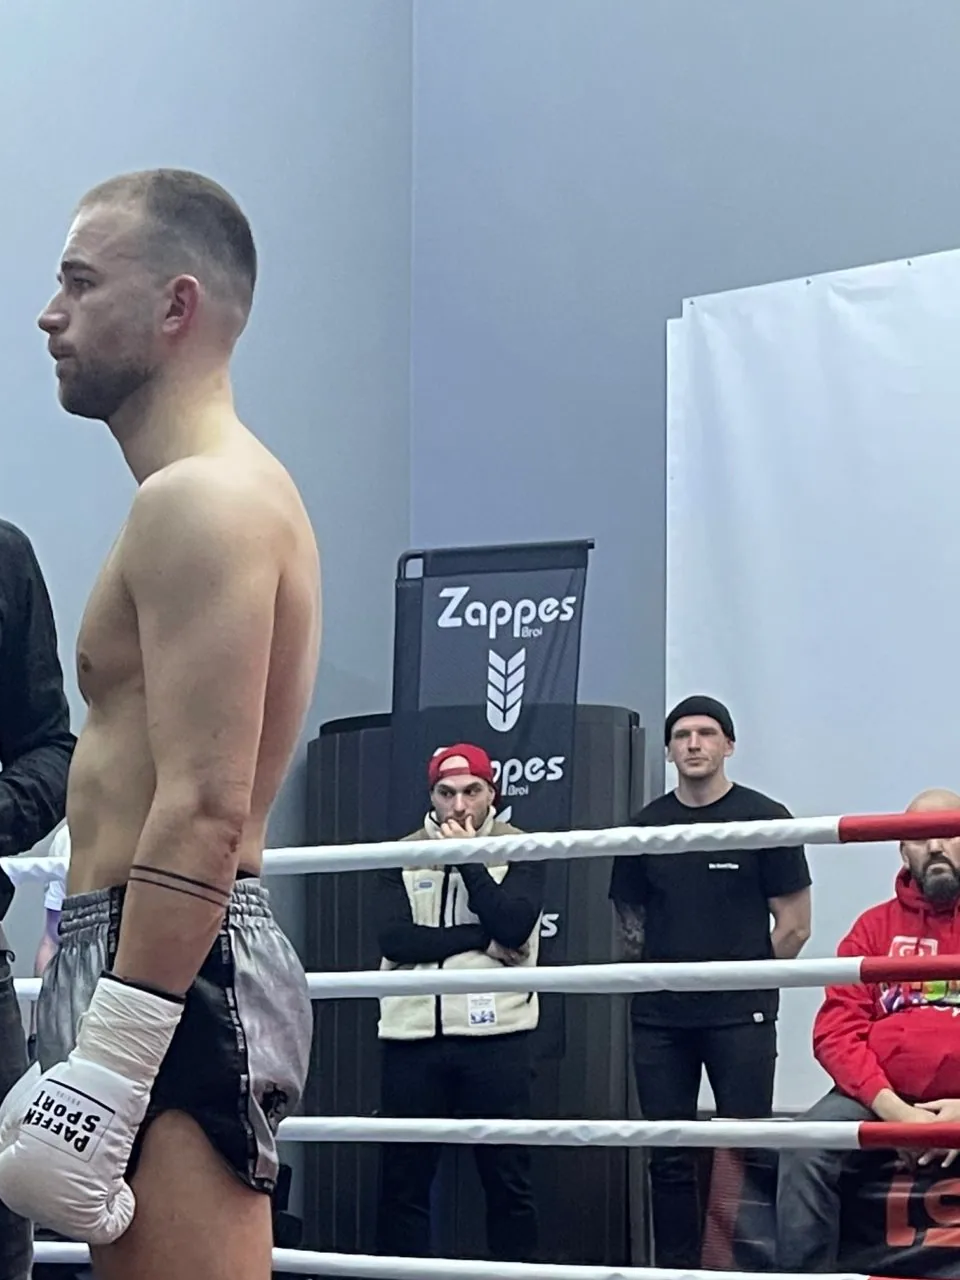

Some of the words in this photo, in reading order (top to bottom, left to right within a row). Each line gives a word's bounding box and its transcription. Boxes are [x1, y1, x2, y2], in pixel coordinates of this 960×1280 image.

[437, 586, 577, 639] Zappes
[22, 1107, 91, 1153] PAFFEN
[32, 1090, 102, 1134] SPORT
